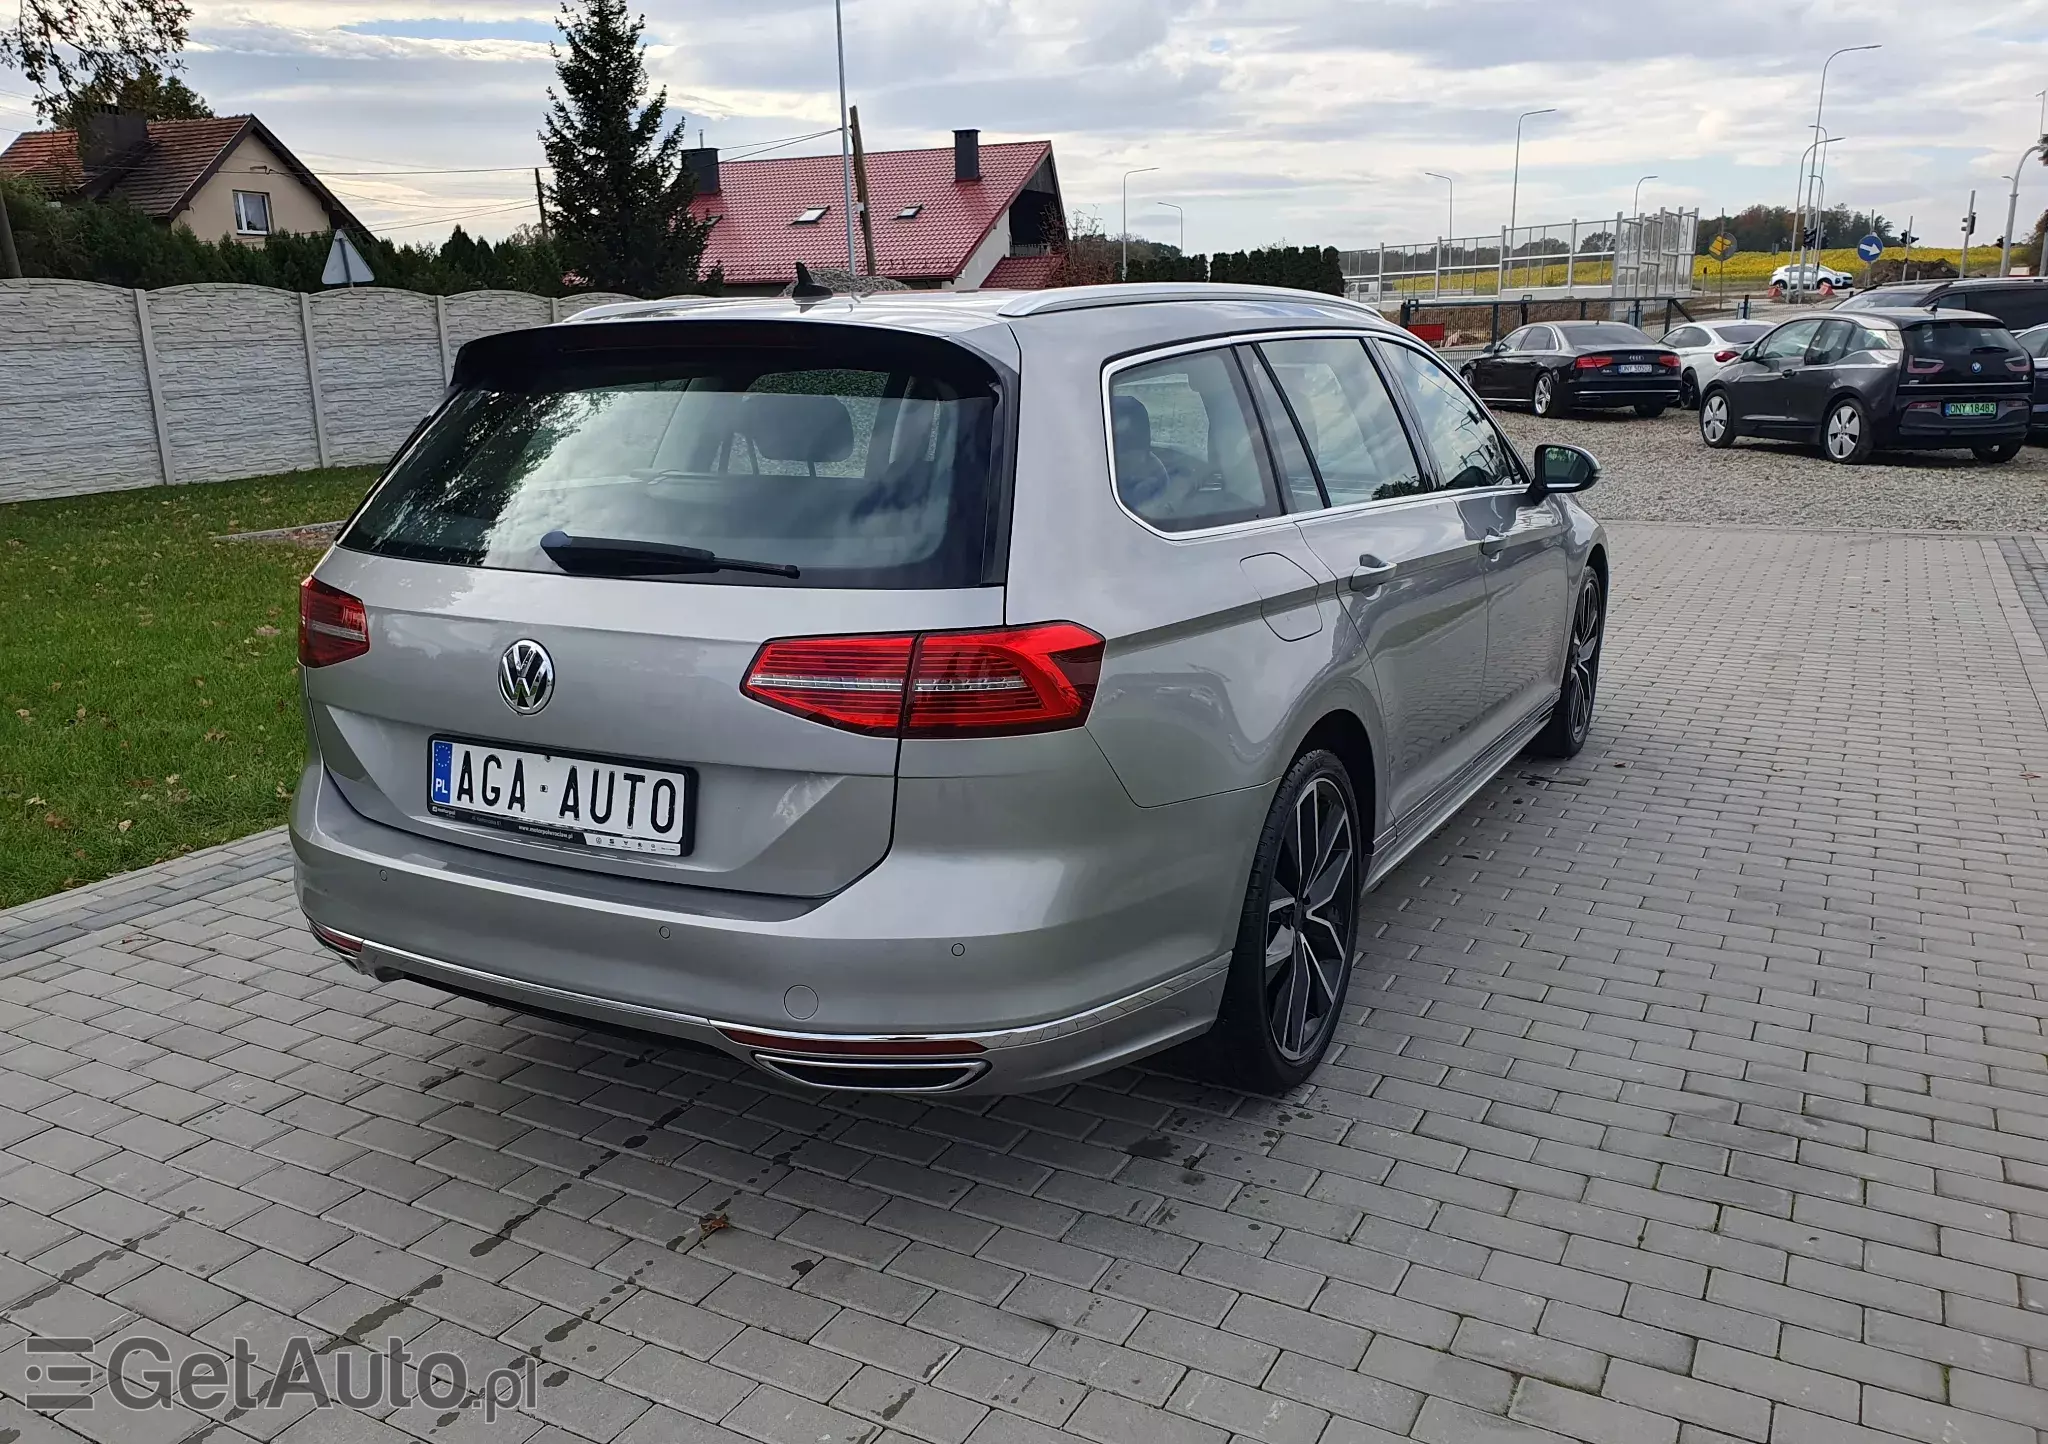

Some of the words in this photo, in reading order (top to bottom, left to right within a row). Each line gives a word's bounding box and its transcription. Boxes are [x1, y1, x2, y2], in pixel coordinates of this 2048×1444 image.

[1950, 403, 1967, 413] ONY
[1970, 403, 1995, 413] 18483
[435, 777, 448, 794] PL
[456, 750, 526, 813] AGA
[558, 765, 677, 834] AUTO
